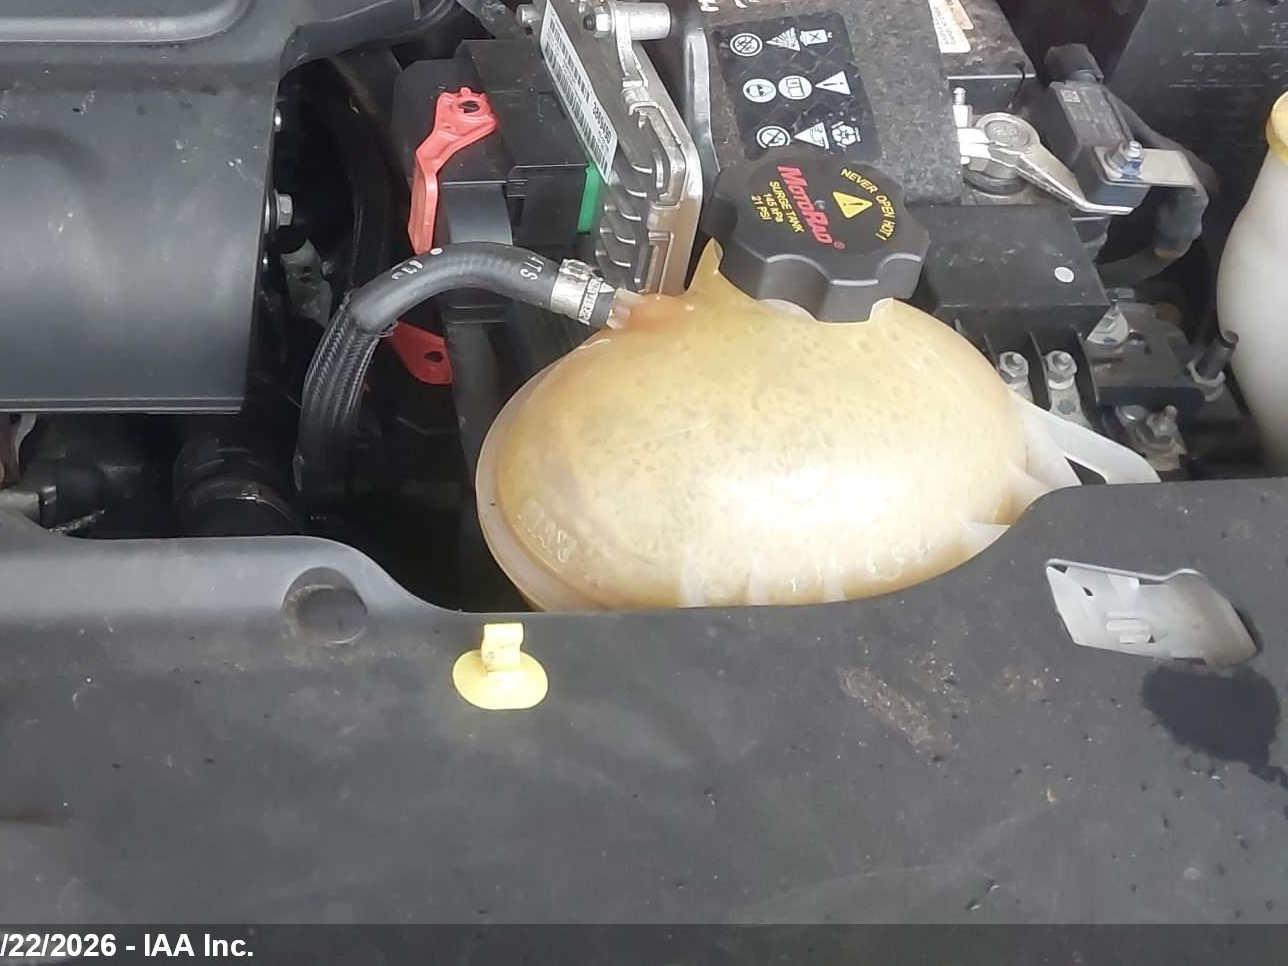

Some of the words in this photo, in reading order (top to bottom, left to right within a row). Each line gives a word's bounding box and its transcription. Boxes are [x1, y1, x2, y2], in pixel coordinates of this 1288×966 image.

[760, 206, 772, 222] PSI
[769, 180, 791, 211] SURGE
[785, 210, 806, 234] TANK
[840, 168, 878, 194] NEVER
[875, 195, 896, 221] OPEN
